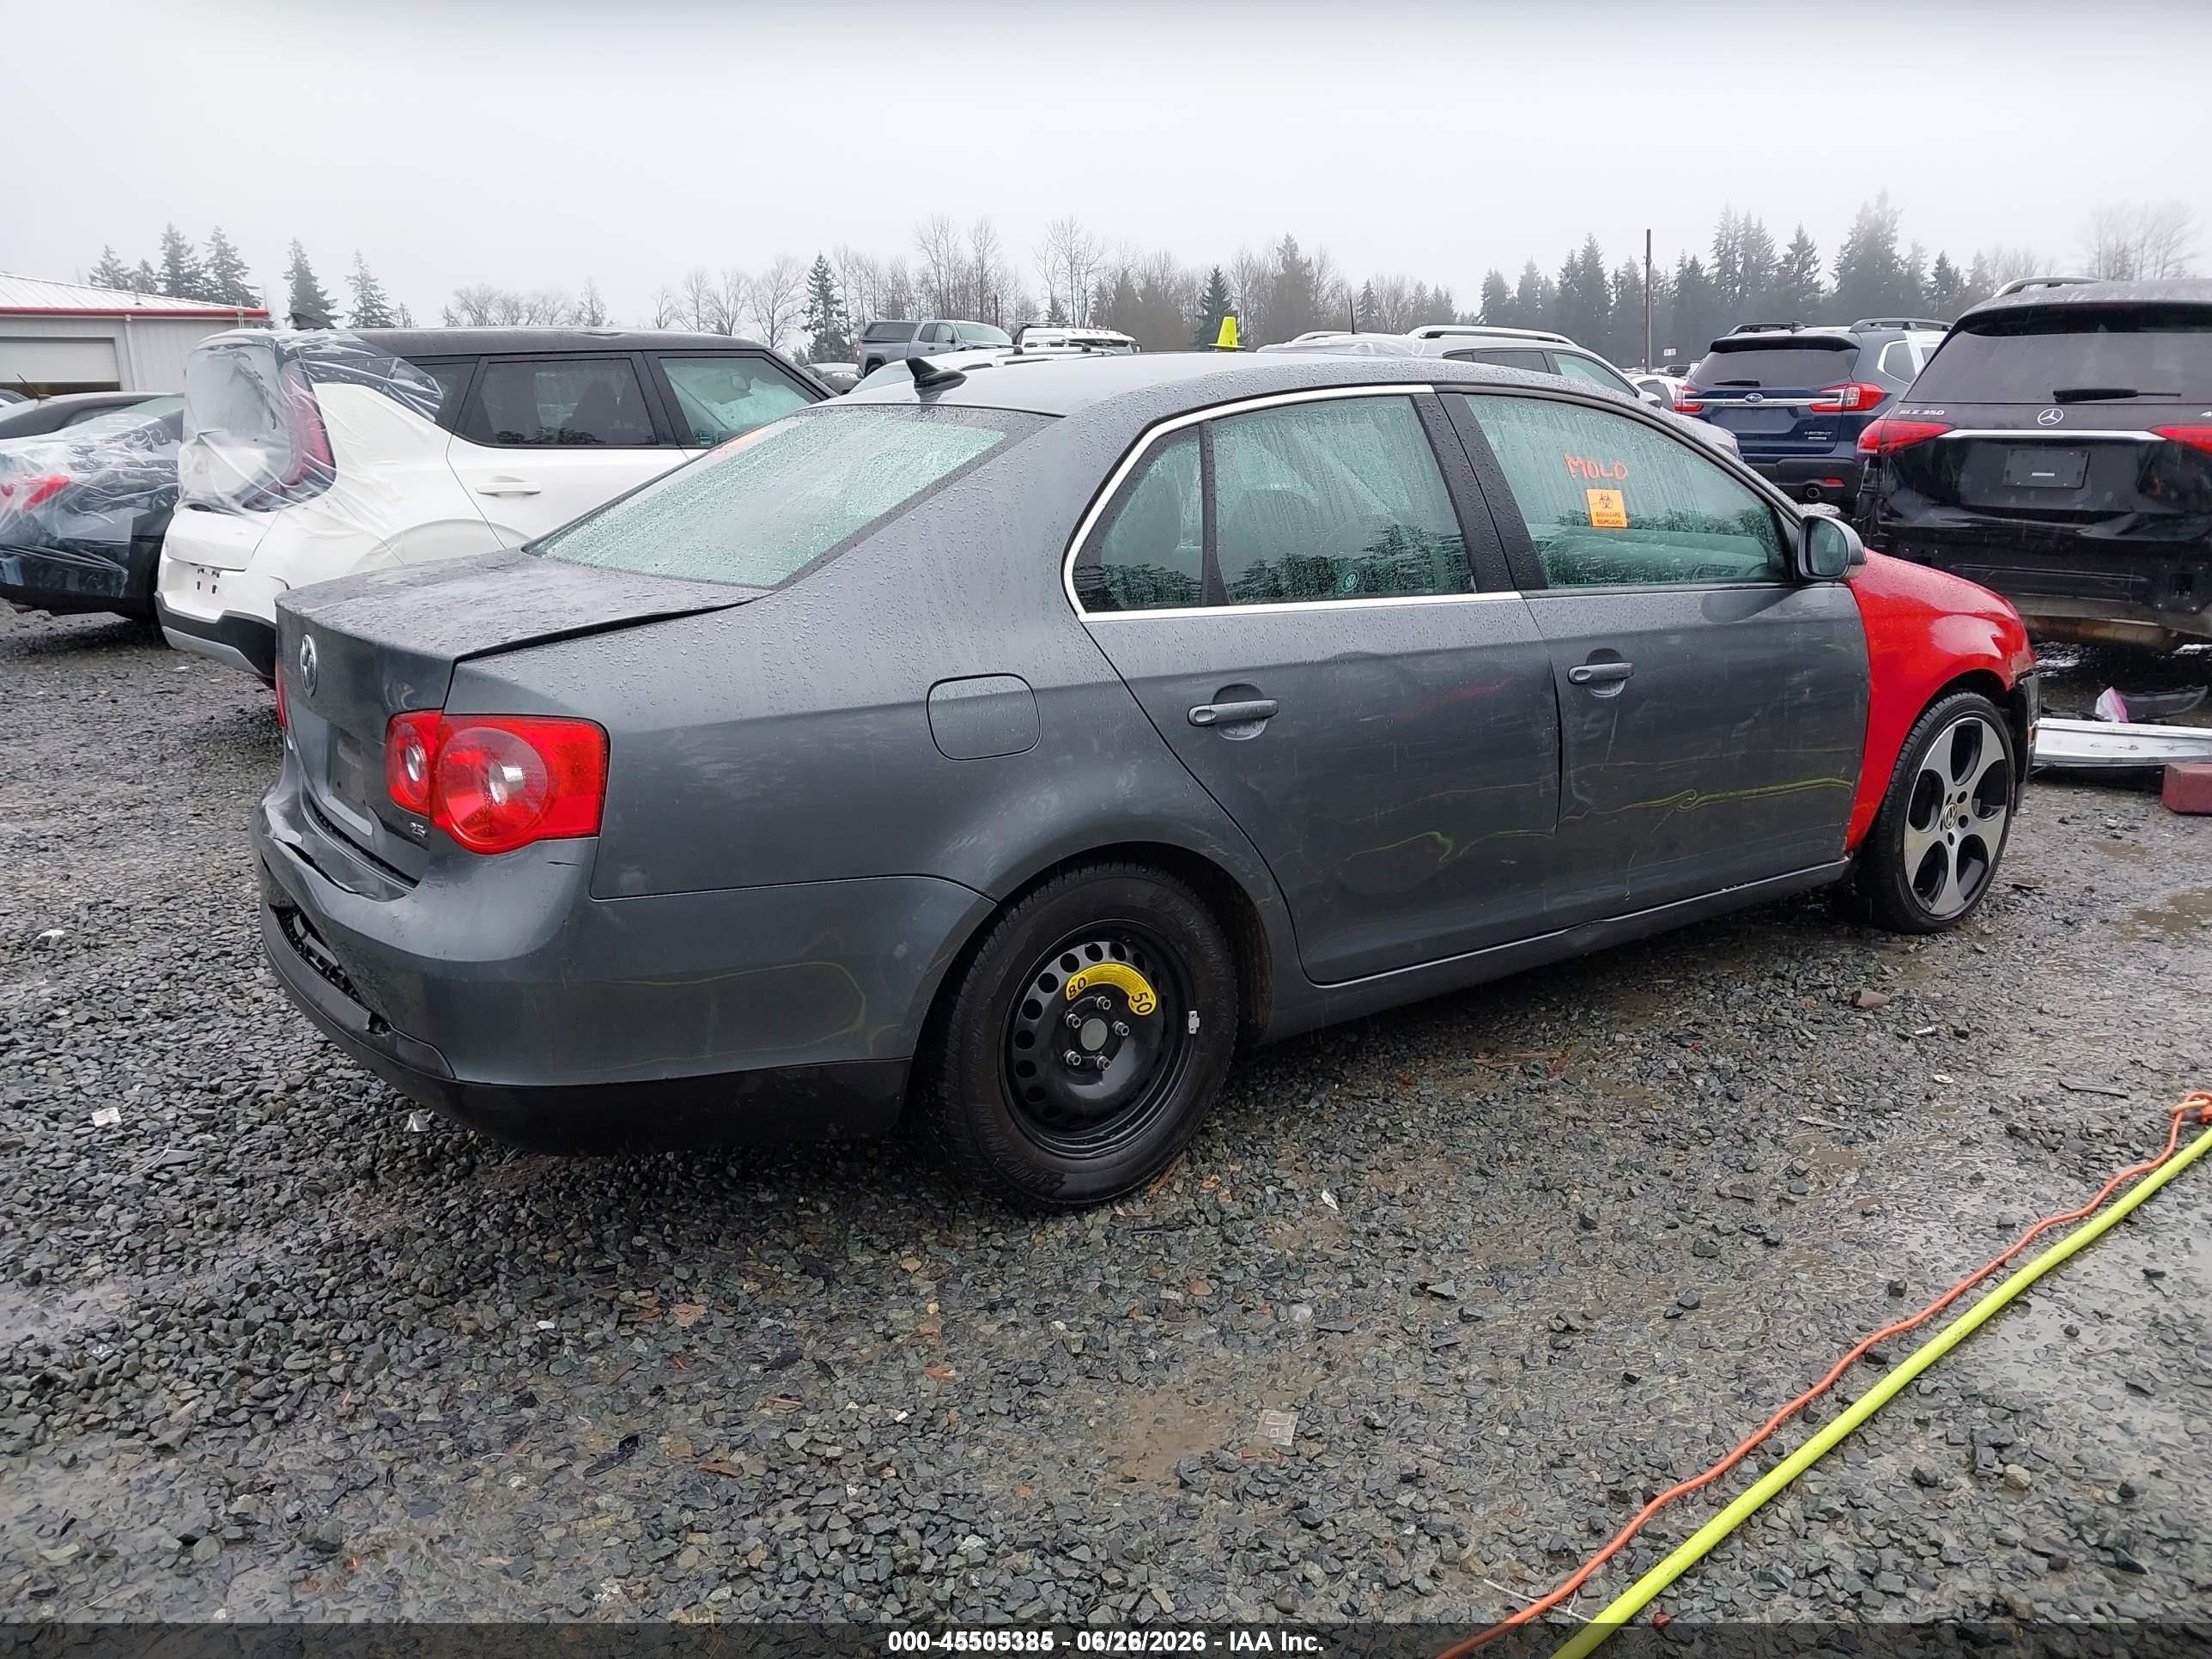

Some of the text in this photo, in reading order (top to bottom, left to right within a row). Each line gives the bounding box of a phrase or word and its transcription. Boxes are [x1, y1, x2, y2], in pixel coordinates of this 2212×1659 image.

[1563, 453, 1628, 480] MOLD
[1068, 976, 1087, 998] 80
[1131, 992, 1152, 1013] 50
